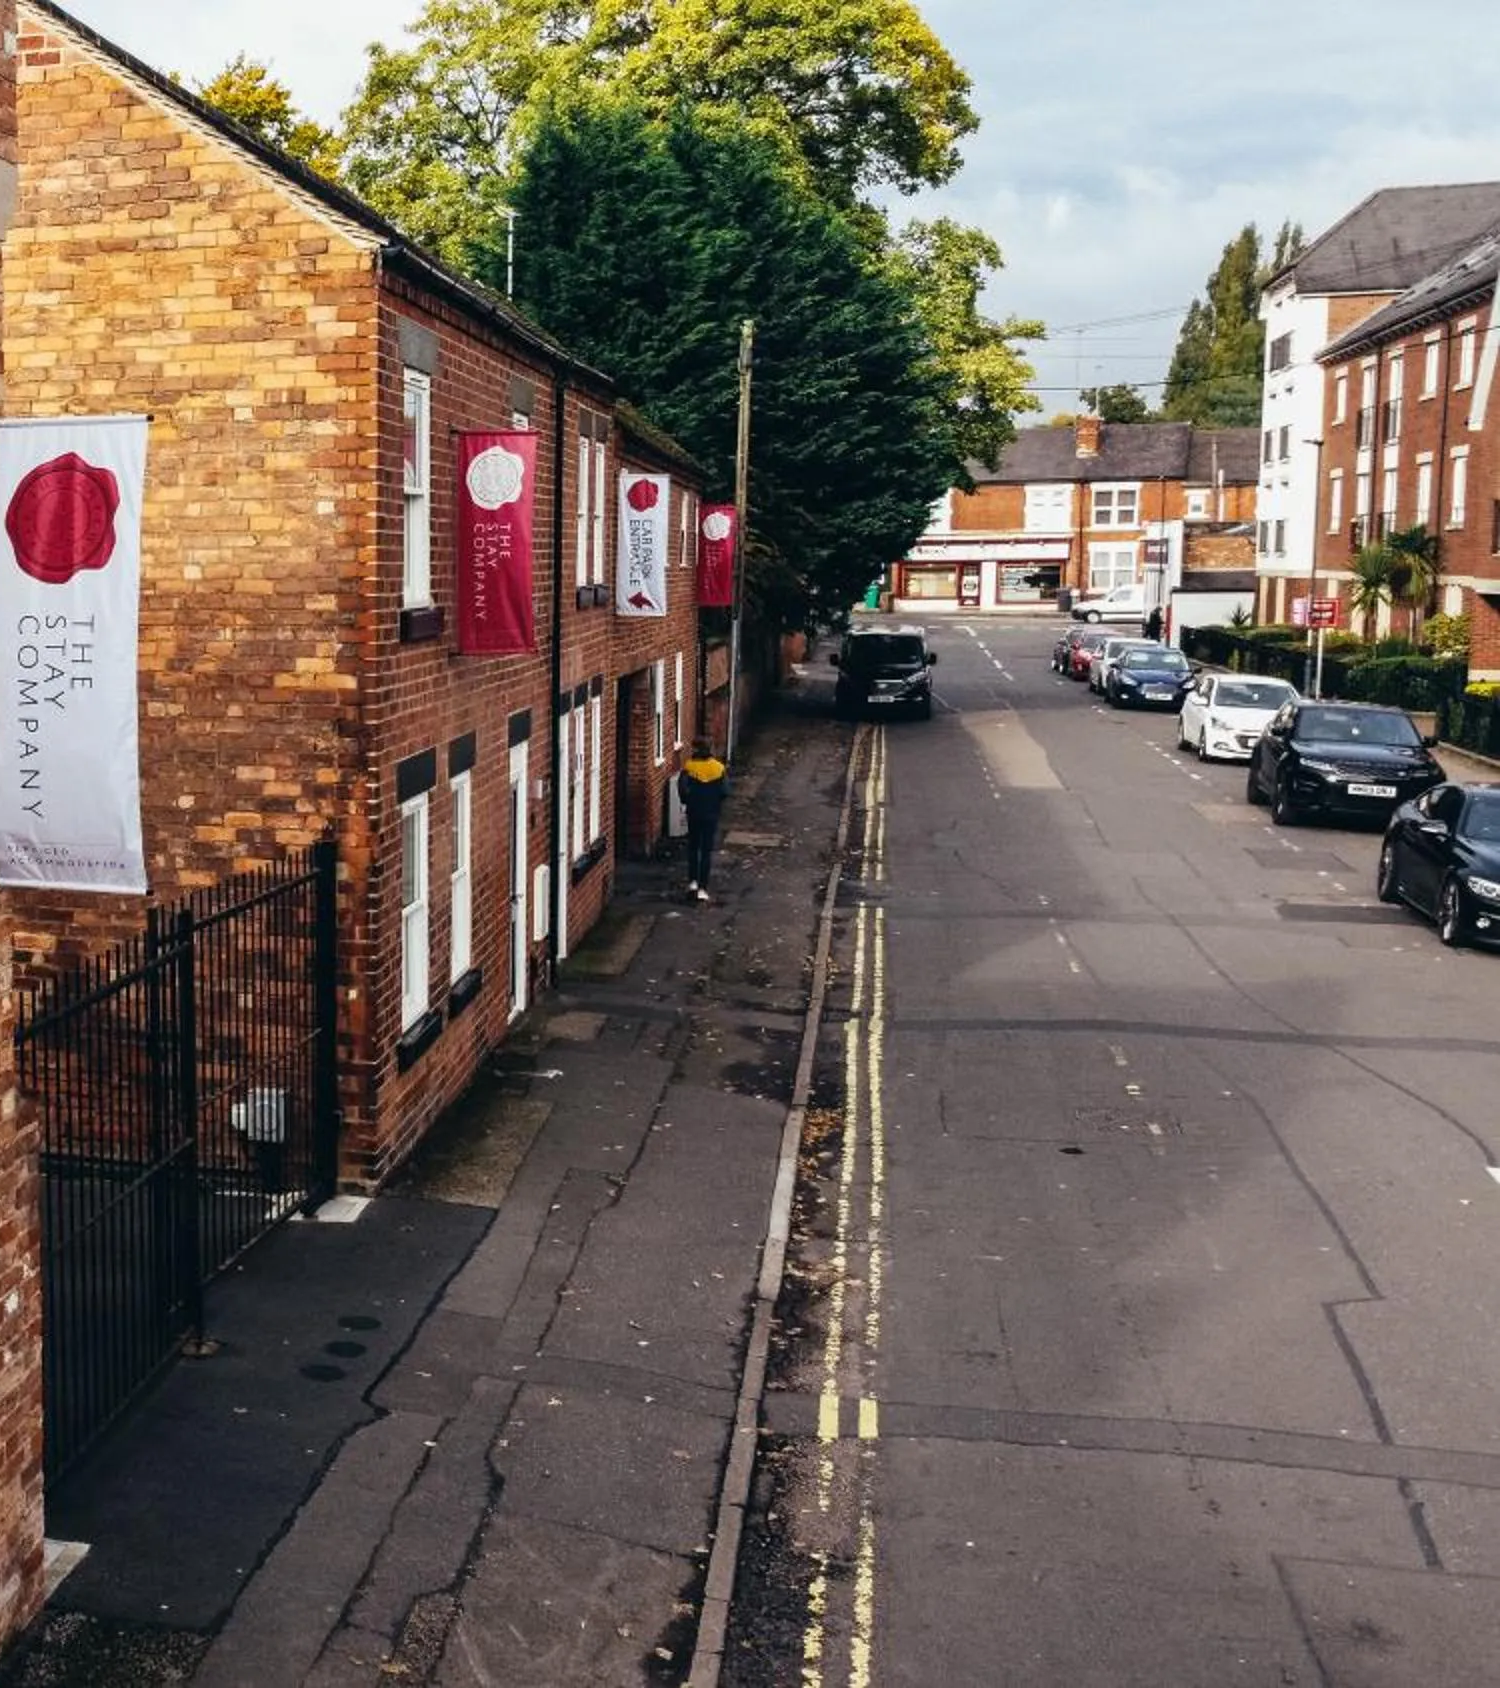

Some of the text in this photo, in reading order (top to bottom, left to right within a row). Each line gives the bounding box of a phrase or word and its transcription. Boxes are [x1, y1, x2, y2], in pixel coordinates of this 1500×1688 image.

[474, 523, 486, 620] COMPANY
[486, 522, 499, 568] STAY
[500, 522, 511, 559] THE
[43, 615, 68, 710] STAY
[70, 614, 95, 689] THE
[17, 615, 45, 819] COMPANY
